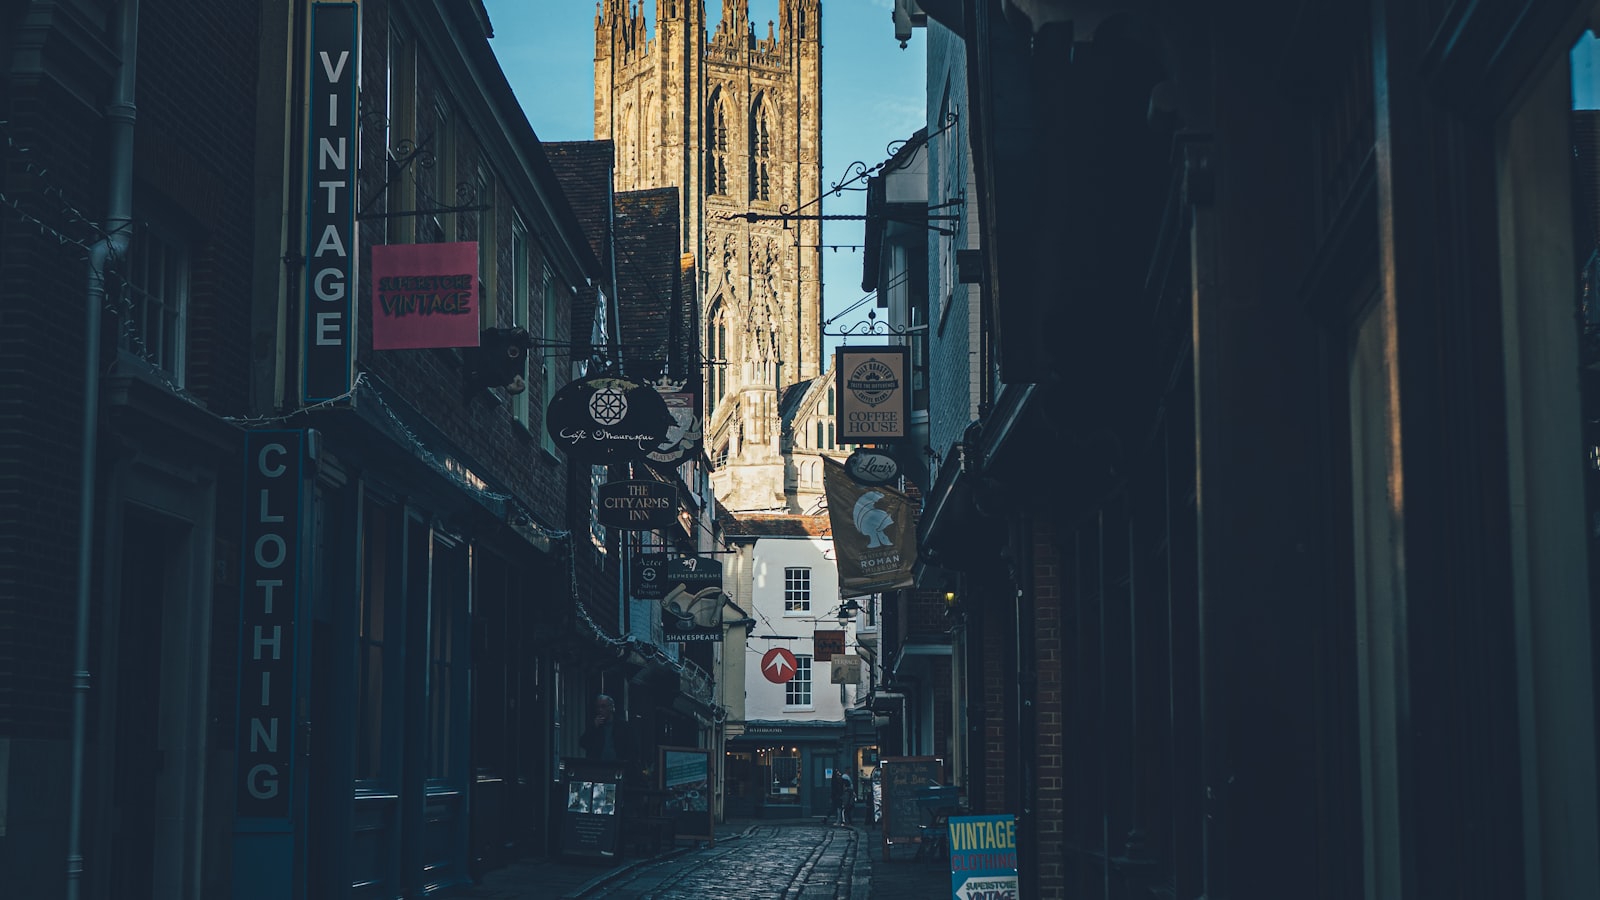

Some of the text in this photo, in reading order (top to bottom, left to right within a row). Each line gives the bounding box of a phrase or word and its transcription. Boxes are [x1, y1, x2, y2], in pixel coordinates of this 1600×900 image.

[314, 50, 349, 347] VINTAGE
[379, 274, 472, 290] SUPERSTORE
[380, 291, 472, 317] VINTAGE
[849, 411, 897, 422] COFFEE
[849, 422, 897, 432] HOUSE
[857, 456, 895, 479] Lazix
[627, 485, 648, 495] THE
[604, 497, 669, 508] CITY ARMS
[629, 510, 649, 520] INN
[861, 554, 900, 568] ROMAN
[247, 443, 287, 801] CLOTHING
[949, 820, 1016, 850] VINTAGE
[952, 853, 1017, 871] CLOTHING
[966, 880, 1017, 890] SUPERSTORE
